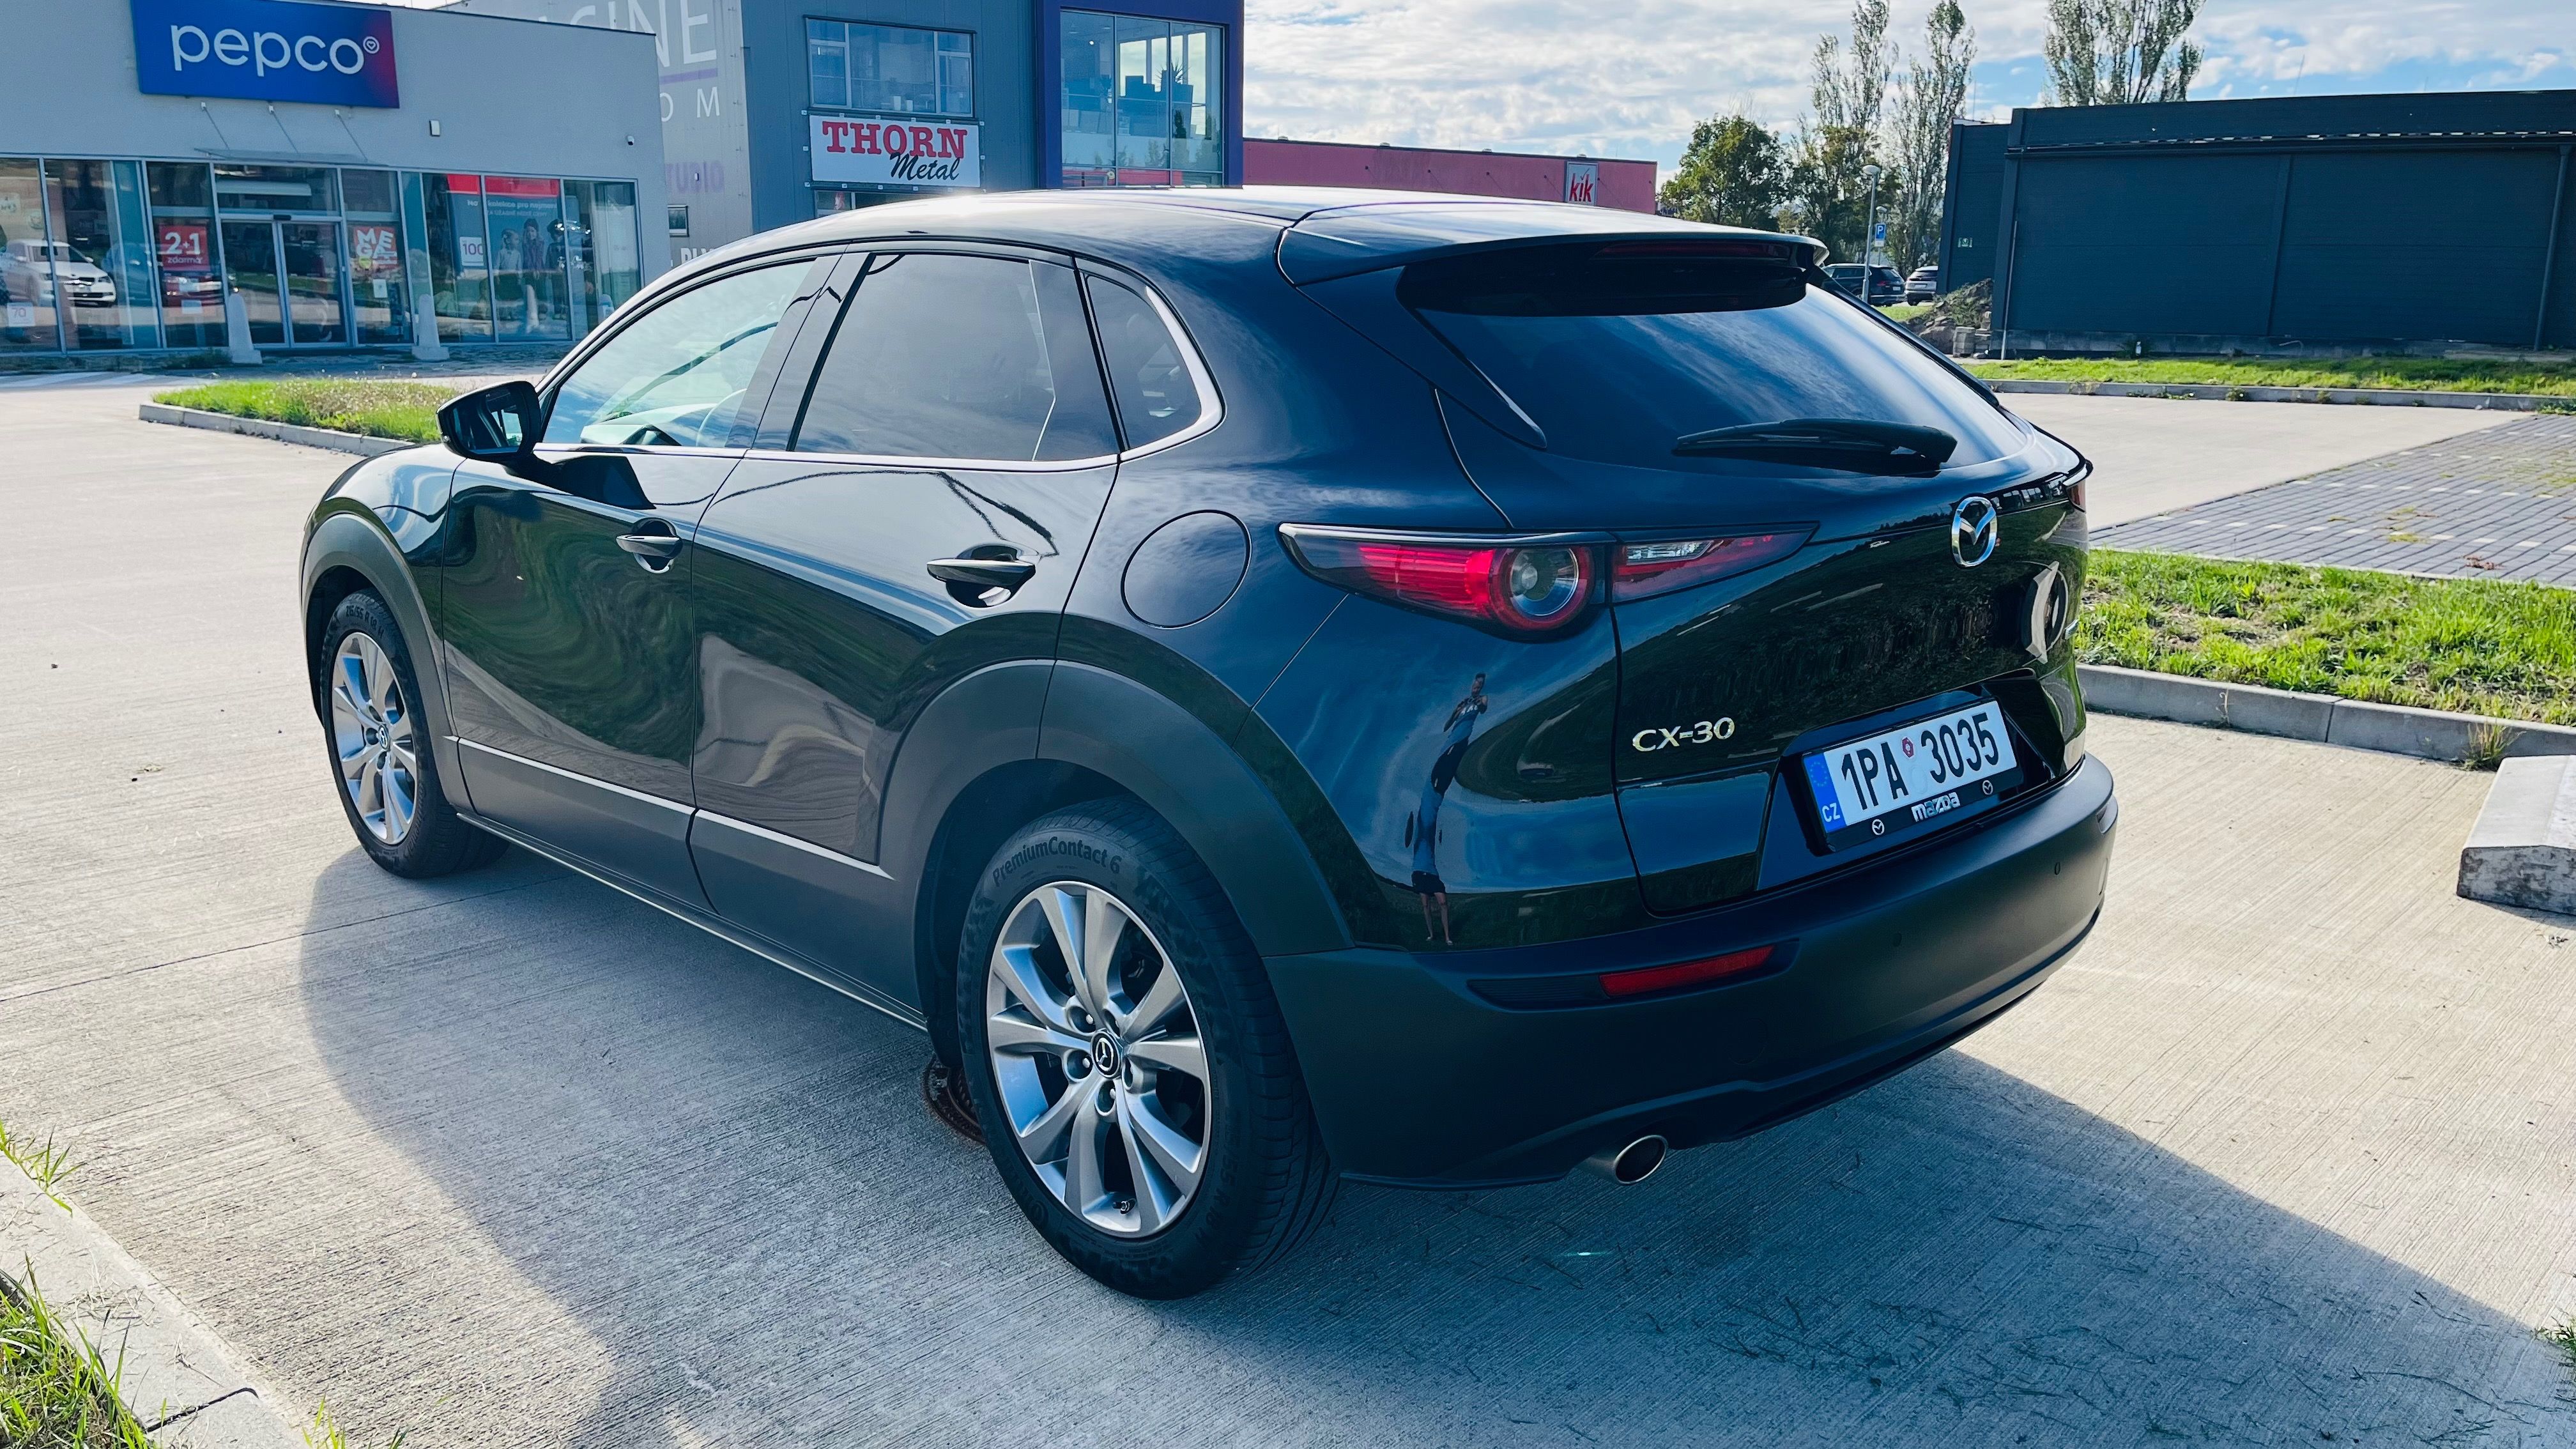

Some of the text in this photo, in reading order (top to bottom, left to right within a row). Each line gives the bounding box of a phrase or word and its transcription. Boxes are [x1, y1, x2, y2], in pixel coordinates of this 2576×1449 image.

[171, 25, 365, 76] pepco
[822, 121, 968, 158] THORN
[890, 152, 960, 180] Metal
[165, 232, 201, 255] 2+1
[1877, 225, 1884, 235] P
[1632, 717, 1735, 752] CX-30
[1841, 712, 1999, 811] 1PA 3035
[1822, 802, 1840, 822] CZ
[992, 836, 1123, 887] PremiumContact 6
